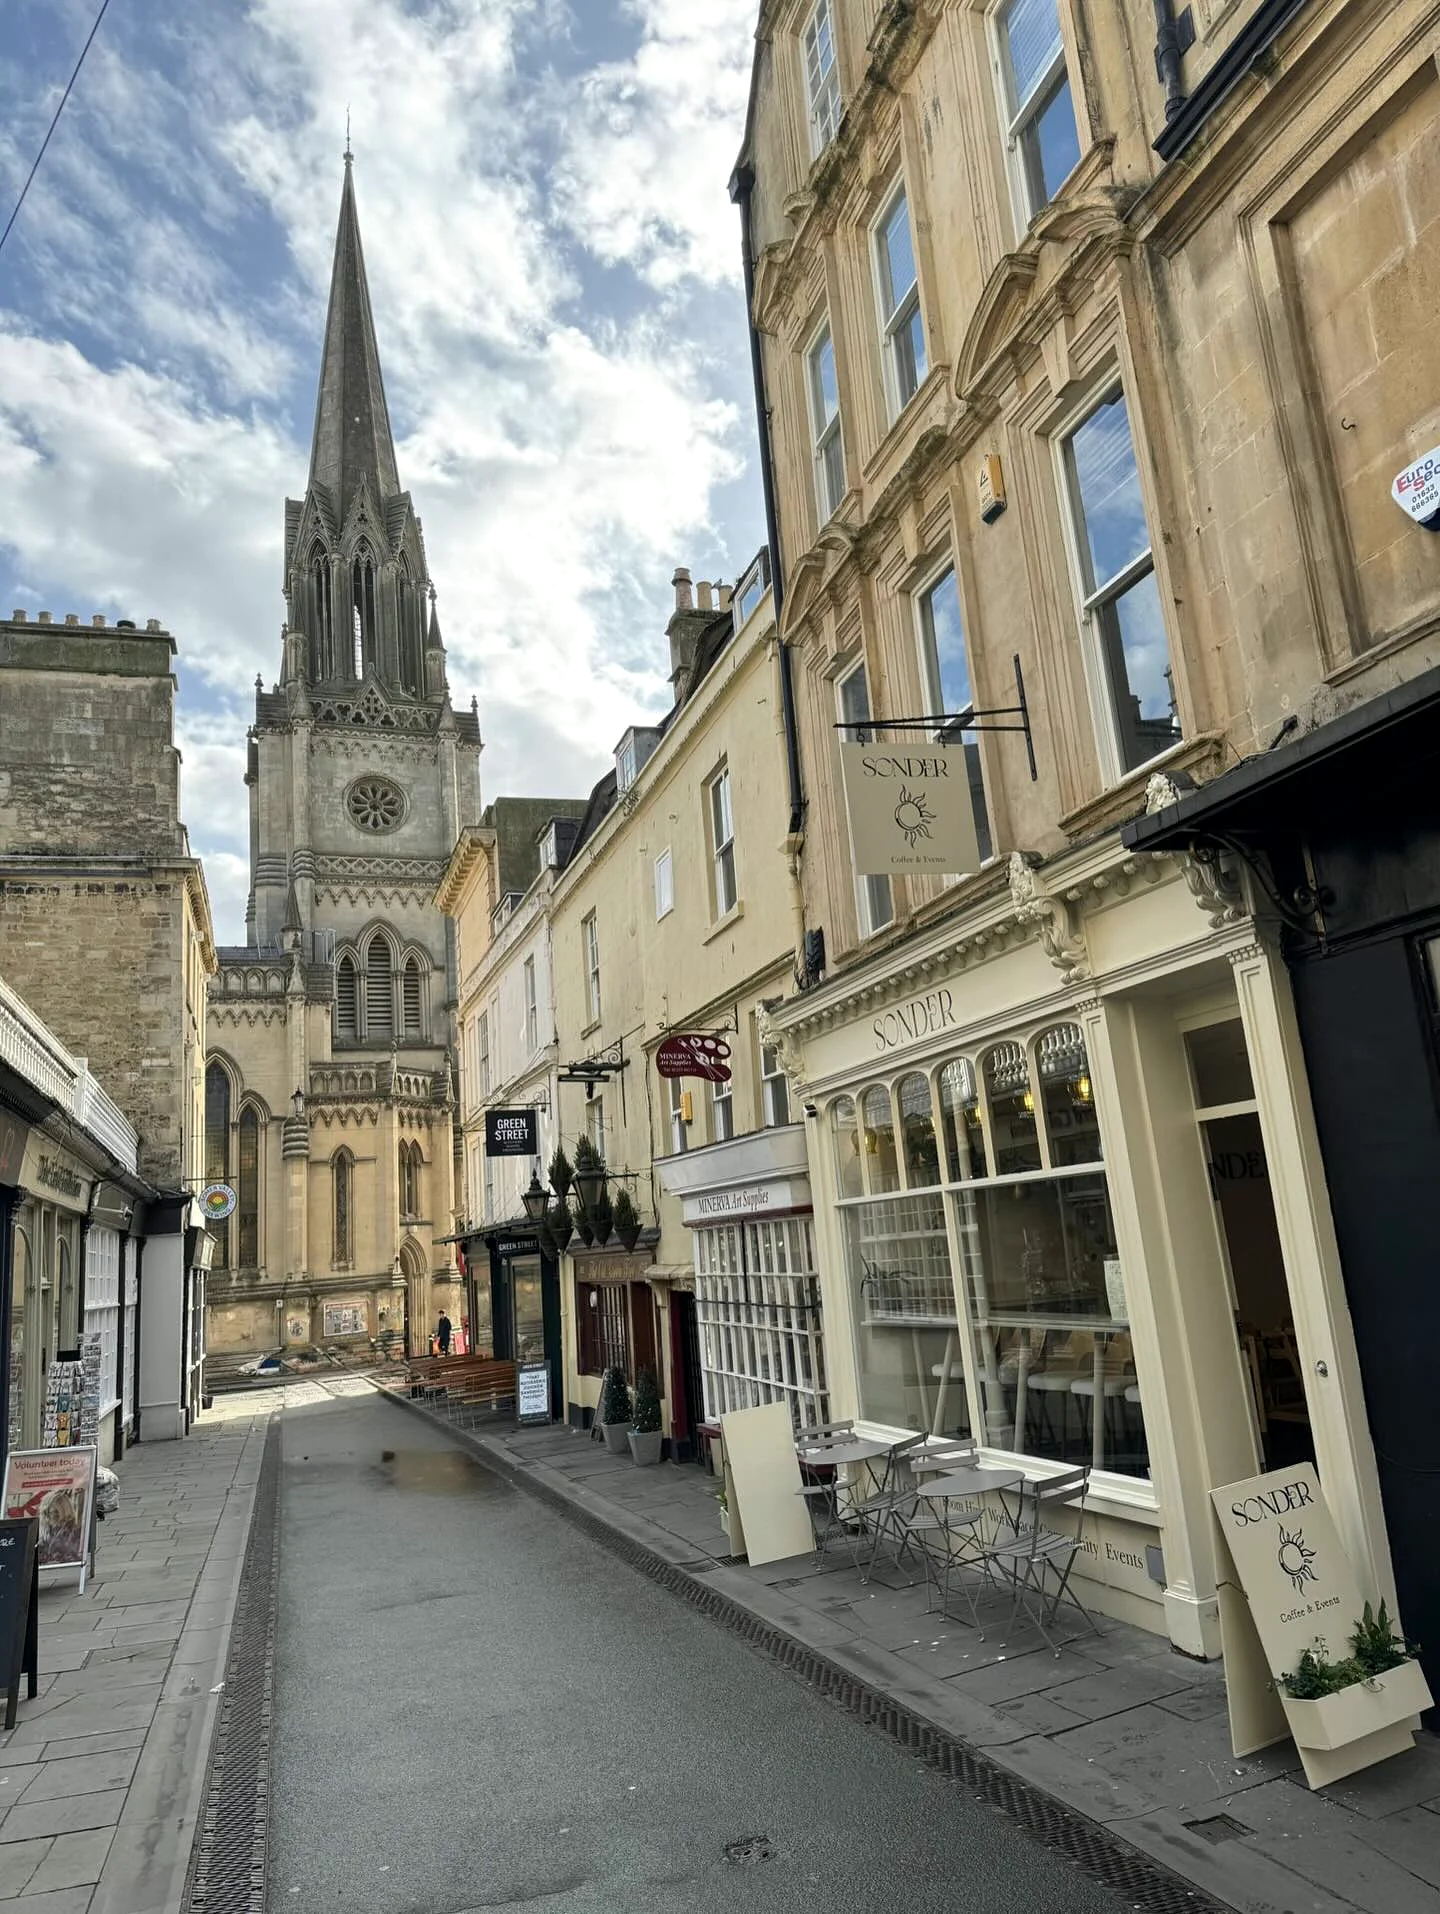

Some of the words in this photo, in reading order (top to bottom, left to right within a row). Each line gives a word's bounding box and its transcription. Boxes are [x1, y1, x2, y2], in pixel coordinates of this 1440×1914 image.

[1397, 459, 1434, 494] Euro
[1412, 484, 1435, 503] 01633
[862, 757, 950, 778] SONDER
[891, 855, 914, 864] Coffee
[916, 855, 921, 863] &
[923, 855, 946, 863] Events
[873, 989, 956, 1051] SONDER
[495, 1129, 529, 1141] STREET
[497, 1118, 526, 1130] GREEN
[1213, 1151, 1266, 1180] NDE
[698, 1194, 731, 1214] MINERVA
[731, 1193, 742, 1209] Art
[743, 1187, 769, 1210] Supplies
[498, 1241, 517, 1251] GREEN
[517, 1239, 537, 1249] STREET
[14, 1459, 57, 1470] Volunteer
[1231, 1481, 1315, 1527] SONDER
[1105, 1542, 1145, 1569] Events
[1280, 1608, 1305, 1623] Coffee
[1307, 1604, 1313, 1614] &
[1316, 1597, 1341, 1611] Events
